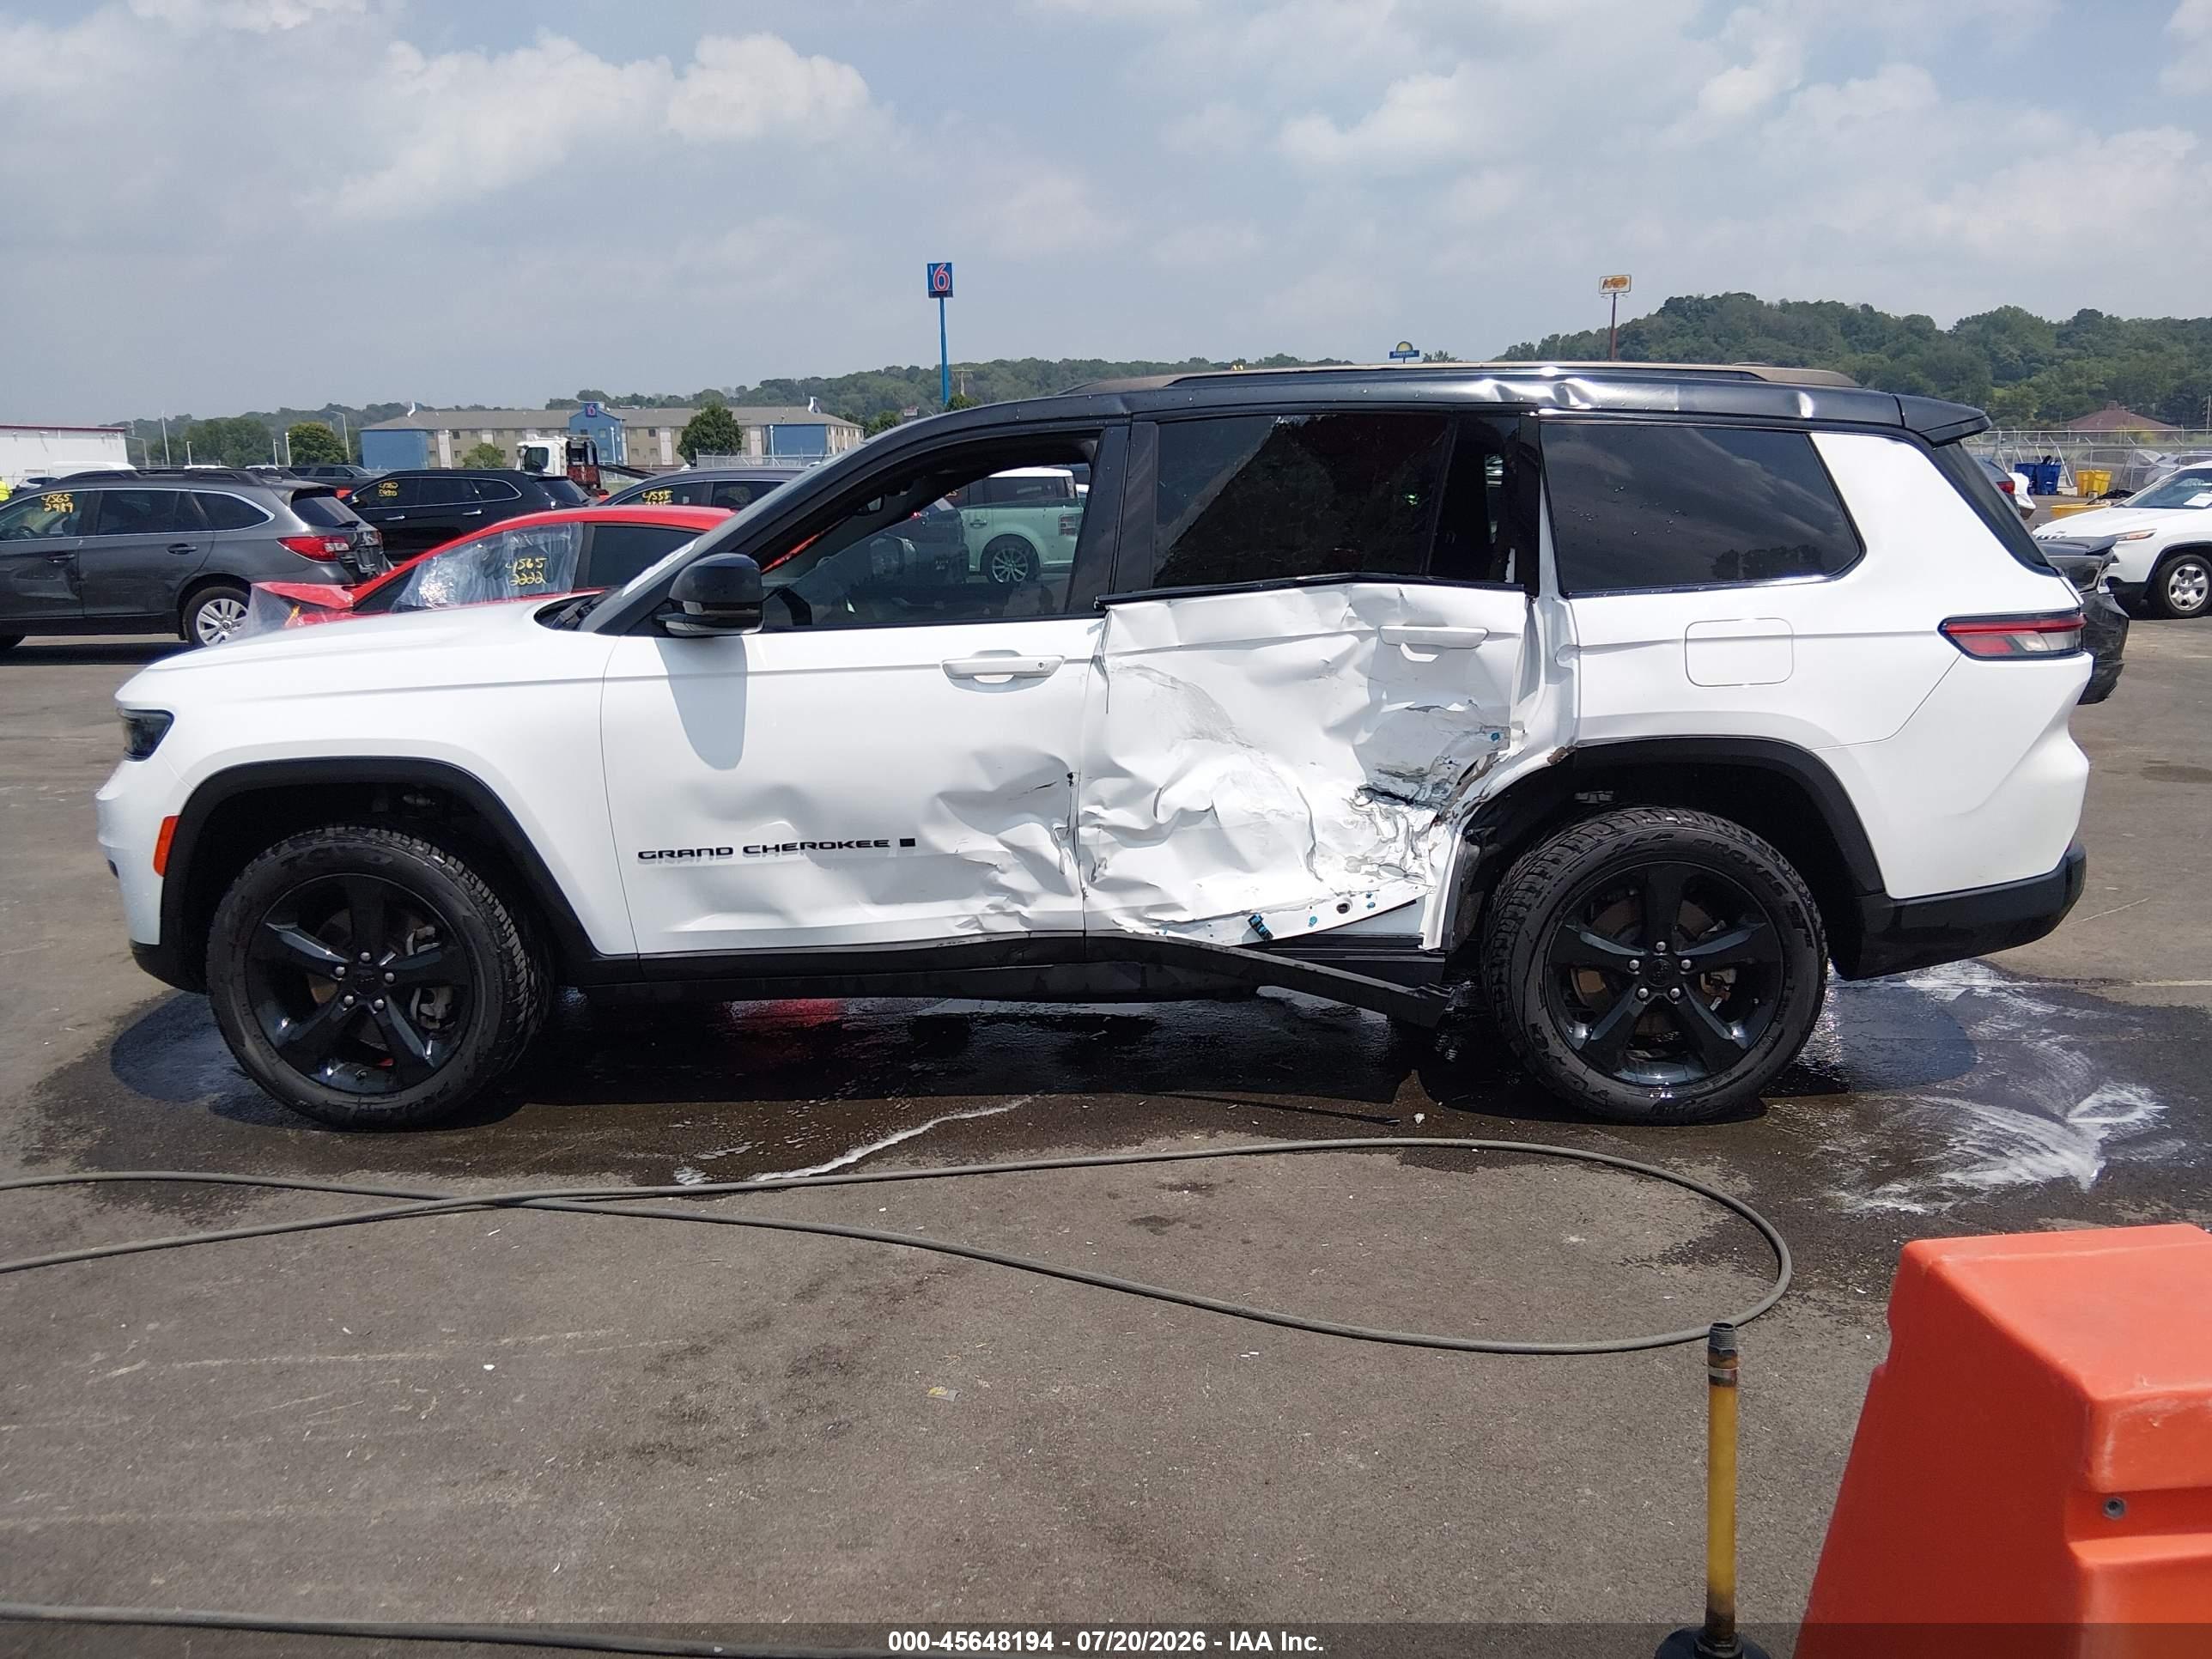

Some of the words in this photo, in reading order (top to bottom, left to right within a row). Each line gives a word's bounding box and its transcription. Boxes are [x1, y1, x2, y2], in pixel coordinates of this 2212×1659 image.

[933, 263, 951, 292] 6
[40, 493, 74, 503] 4565
[43, 501, 74, 514] 2989
[505, 557, 548, 574] 4565
[508, 571, 547, 586] 2222
[637, 845, 735, 860] GRAND
[743, 838, 890, 855] CHEROKEE
